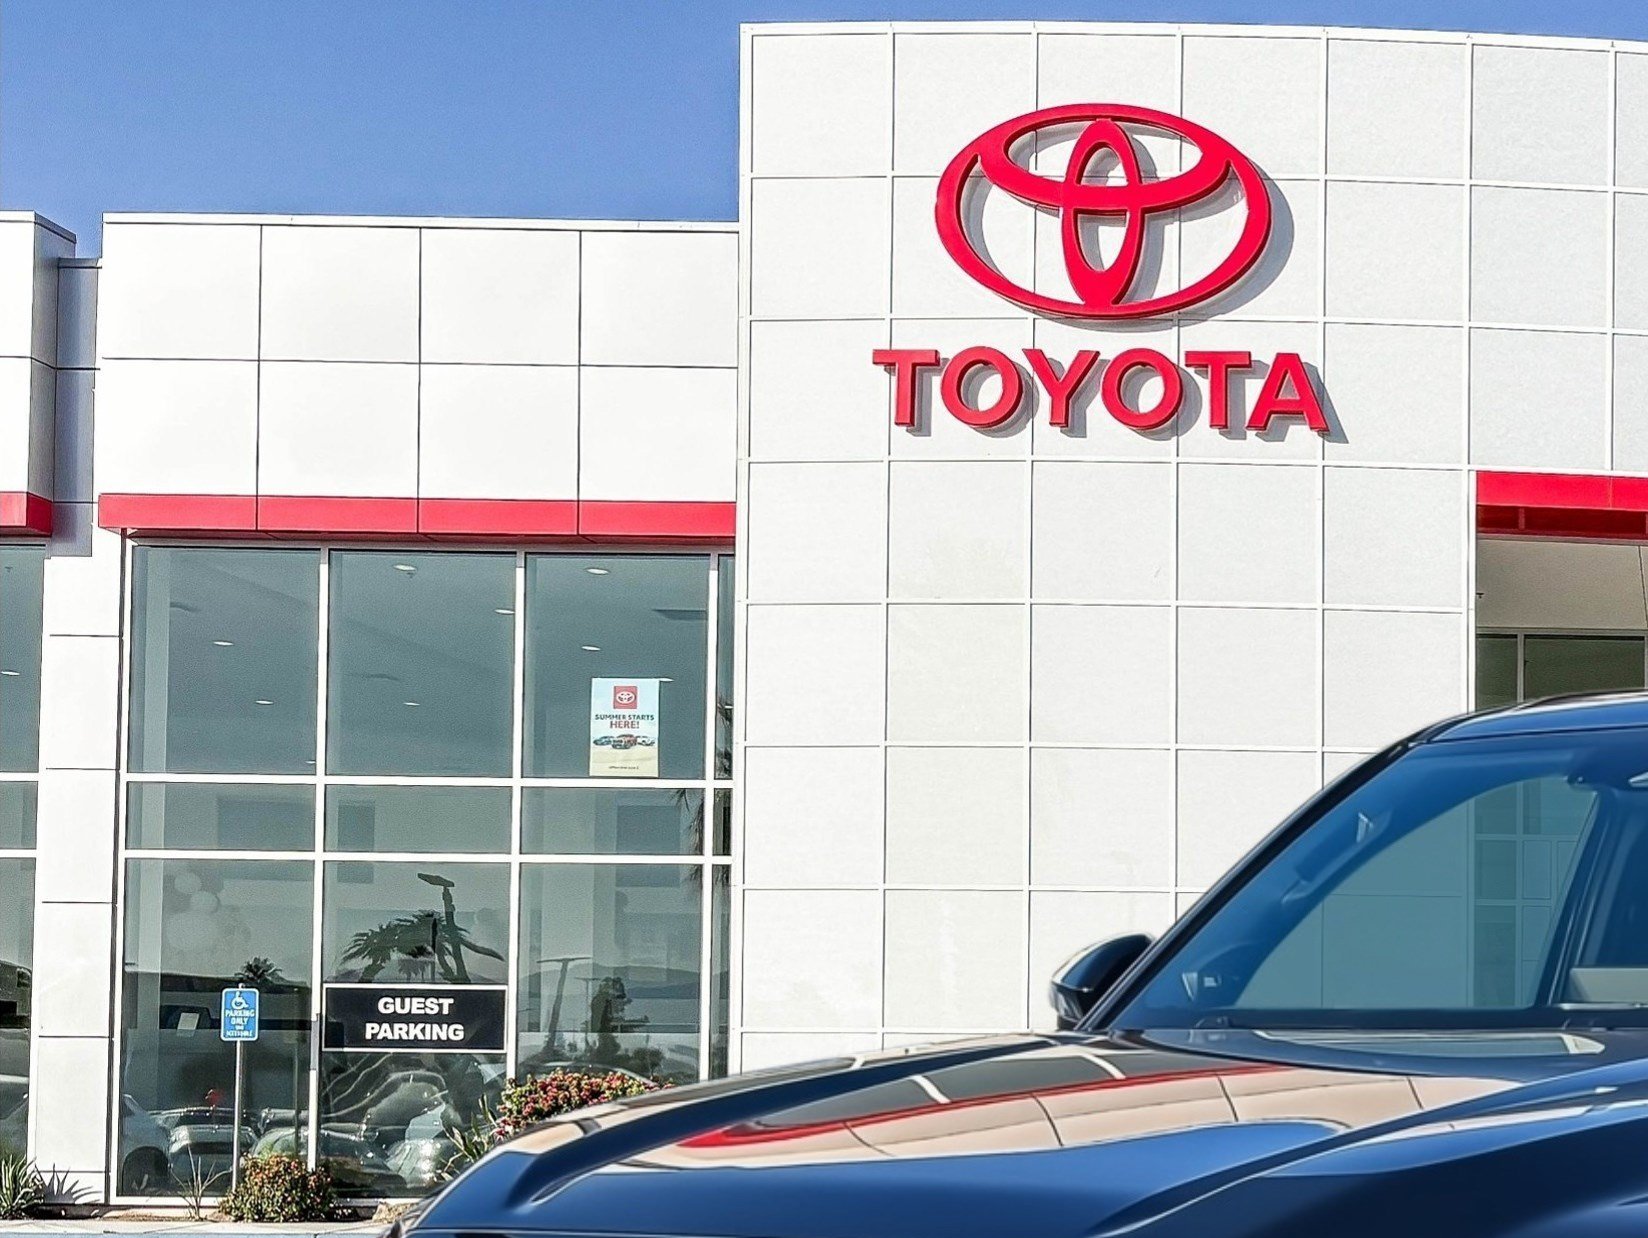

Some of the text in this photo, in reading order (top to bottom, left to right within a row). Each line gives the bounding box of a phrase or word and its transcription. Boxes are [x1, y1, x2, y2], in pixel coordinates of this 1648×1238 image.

[872, 346, 1330, 434] TOYOTA
[595, 713, 655, 721] SUMMER STARTS
[610, 721, 640, 729] HERE!
[378, 997, 454, 1015] GUEST
[225, 1009, 255, 1017] PARKING
[365, 1022, 464, 1041] PARKING
